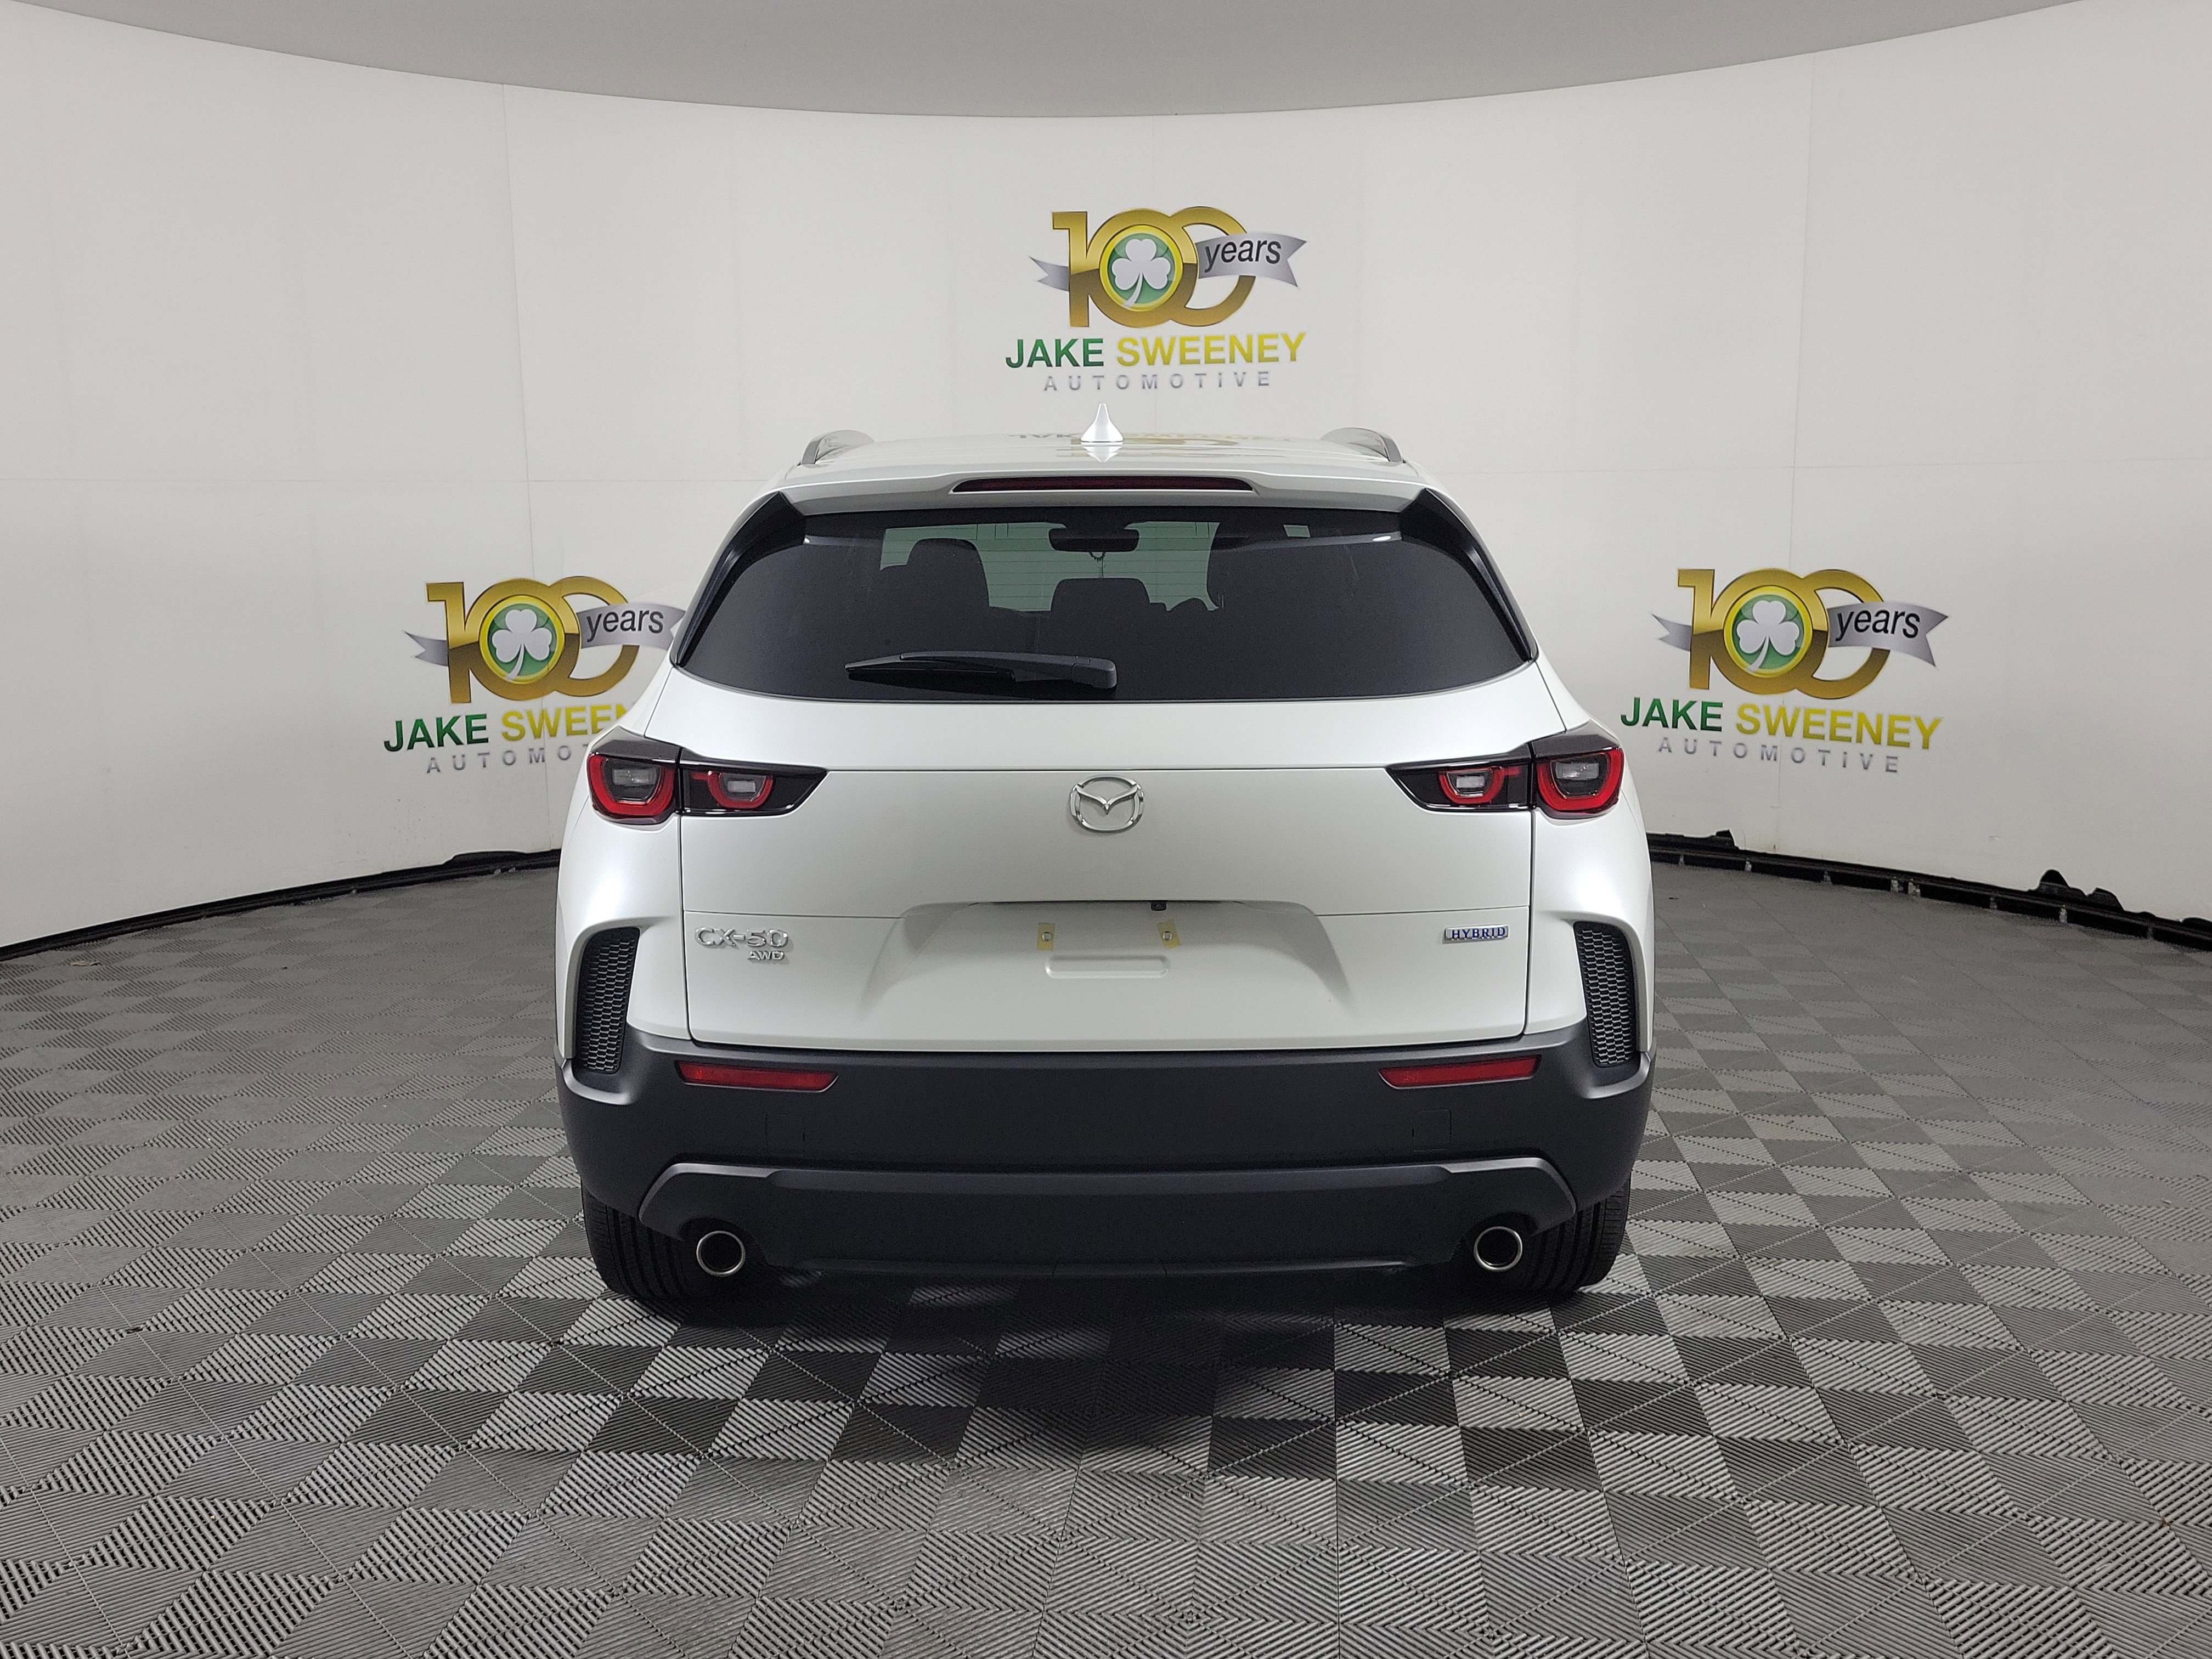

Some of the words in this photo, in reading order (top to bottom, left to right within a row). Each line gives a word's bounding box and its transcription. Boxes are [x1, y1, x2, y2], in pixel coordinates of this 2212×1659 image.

[1051, 206, 1256, 328] 100
[1204, 239, 1282, 273] years
[1005, 338, 1104, 368] JAKE
[1116, 332, 1306, 367] SWEENEY
[1043, 371, 1270, 391] AUTOMOTIVE
[426, 575, 640, 703] 100
[586, 608, 664, 642] years
[1677, 568, 1891, 699] 100
[1835, 608, 1921, 641] years
[383, 714, 489, 752] JAKE
[1620, 697, 1724, 732] JAKE
[1735, 703, 1942, 750] SWEENEY
[426, 743, 588, 774] AUTOMO
[1658, 737, 1899, 774] AUTOMOTIVE
[695, 927, 789, 948] CX-50
[1451, 927, 1506, 939] HYBRID
[748, 951, 785, 961] AWD
